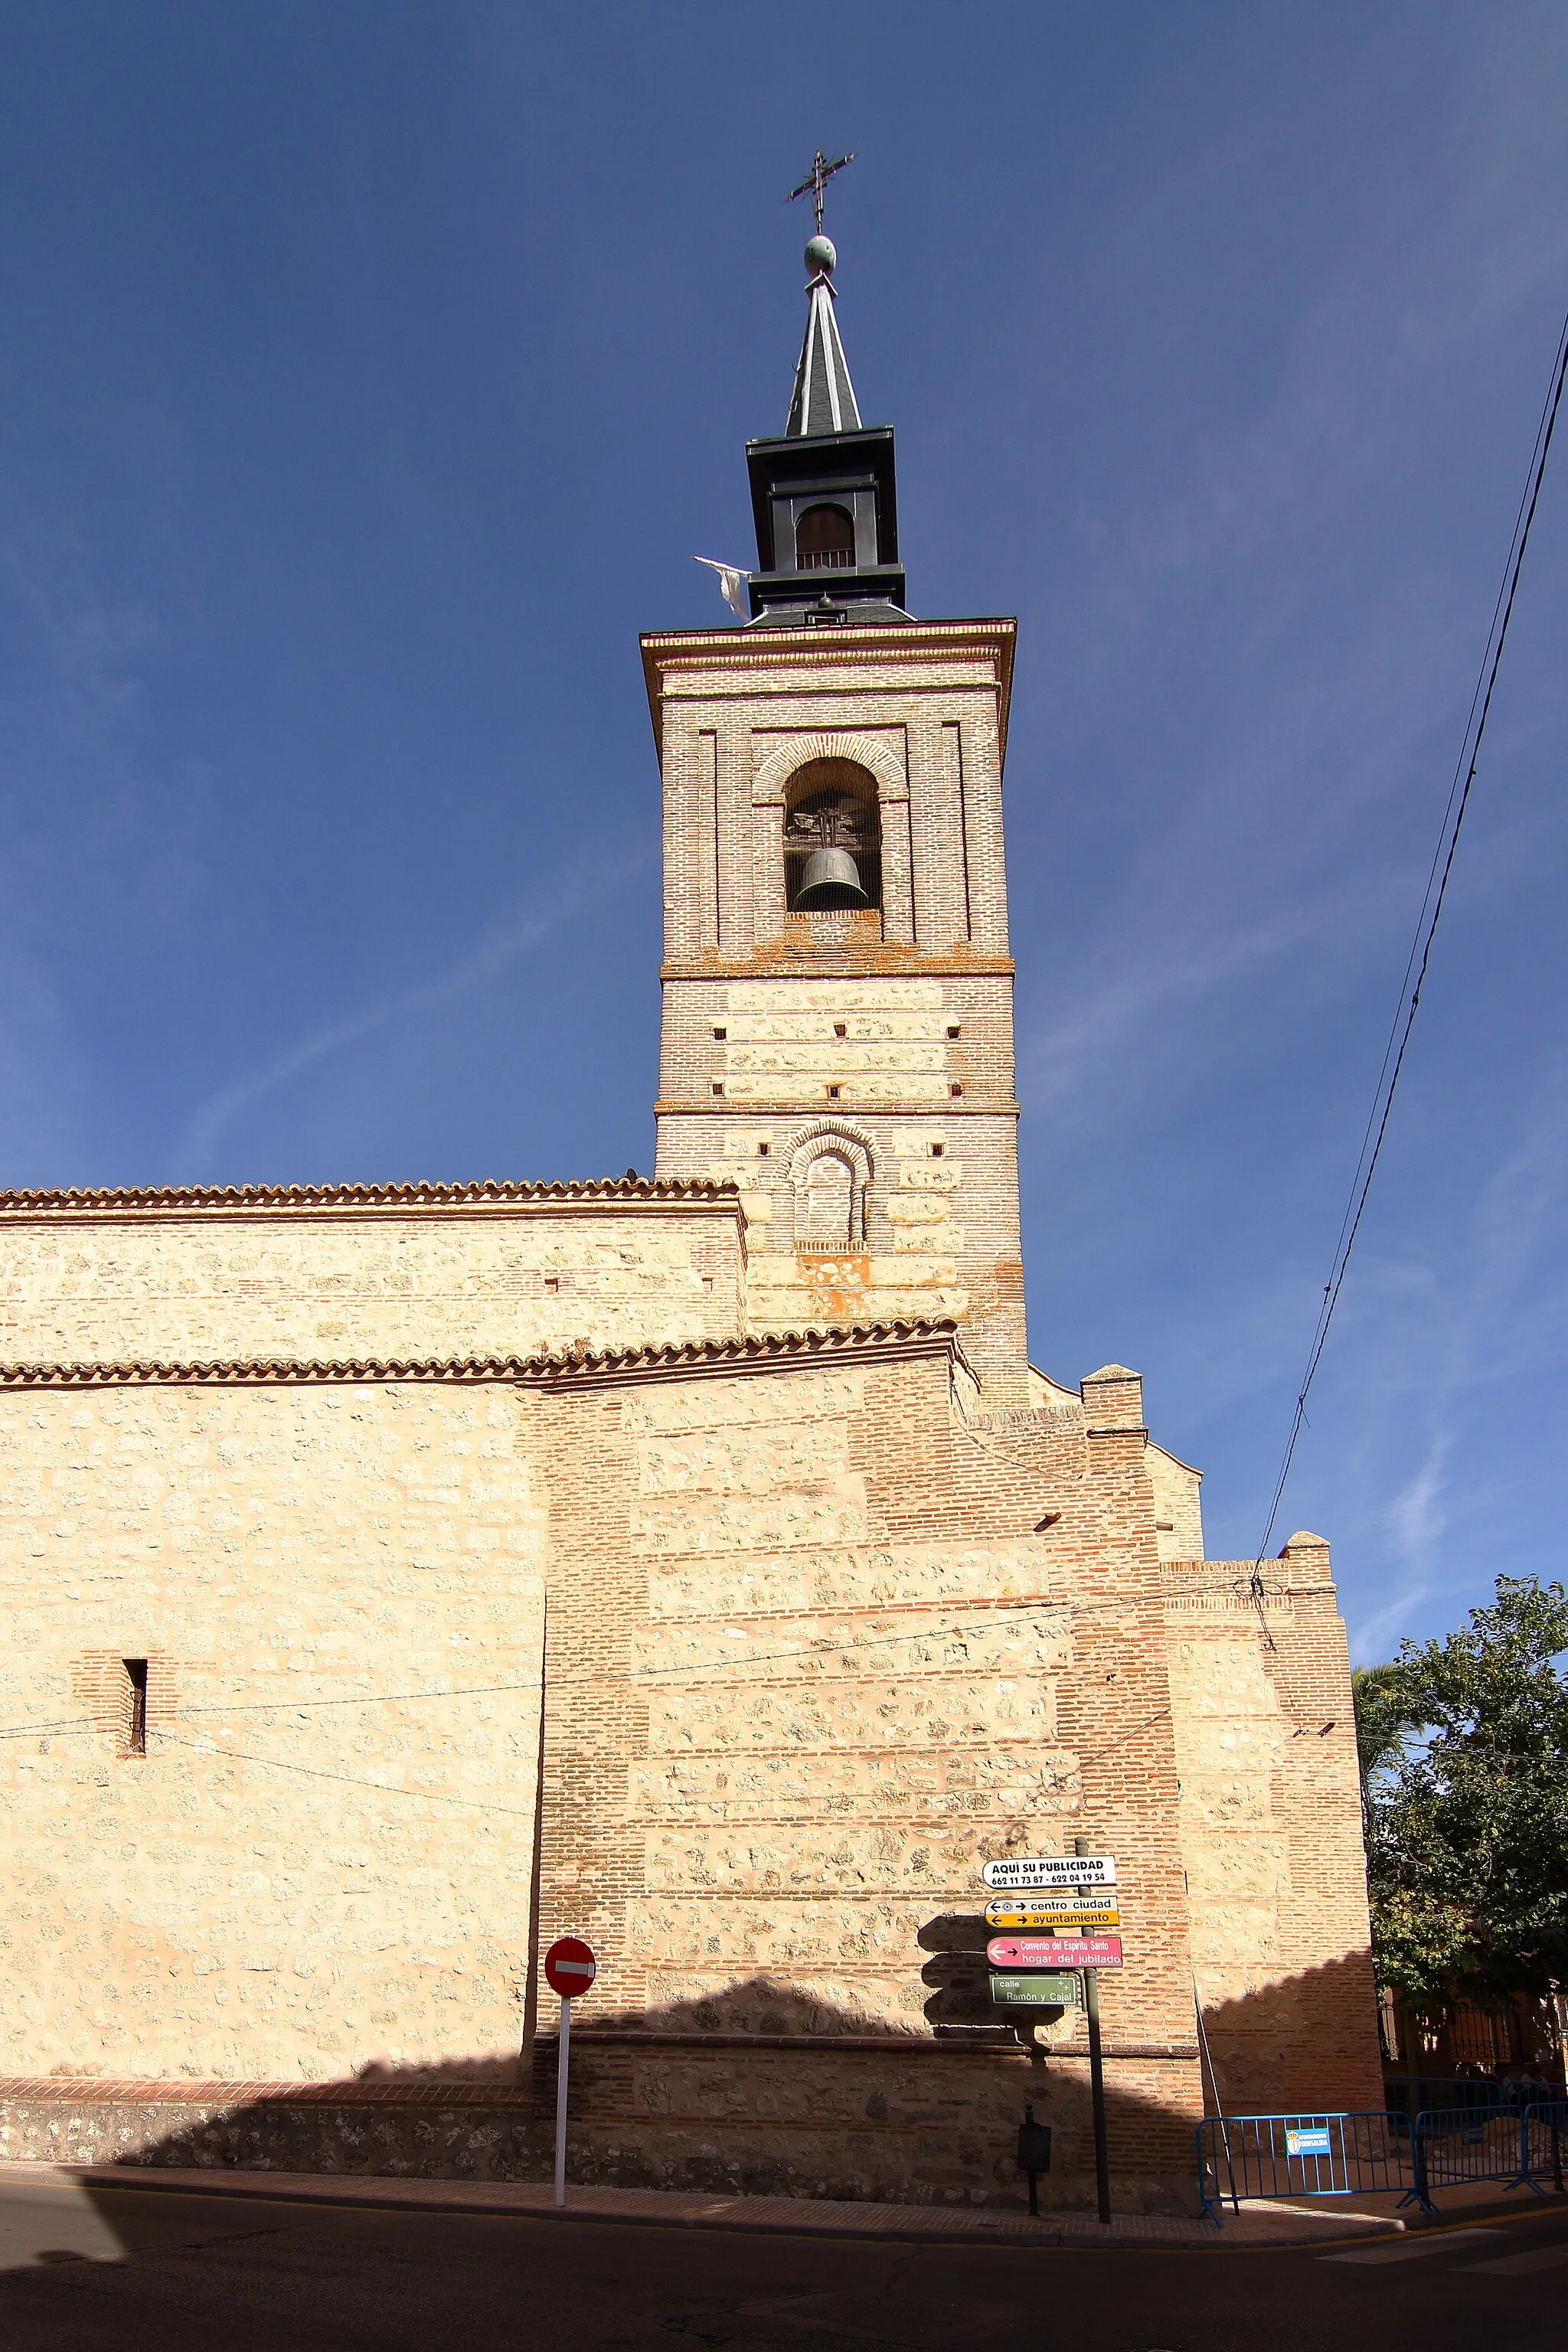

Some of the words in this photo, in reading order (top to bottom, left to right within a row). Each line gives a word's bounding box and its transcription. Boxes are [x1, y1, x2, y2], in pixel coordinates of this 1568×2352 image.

[992, 1862, 1020, 1874] AQUÍ
[1023, 1864, 1036, 1873] SU
[1040, 1860, 1104, 1872] PUBLICIDAD
[1095, 1873, 1105, 1881] 54
[1031, 1902, 1067, 1910] centro
[1073, 1900, 1111, 1909] ciudad
[1033, 1913, 1109, 1925] ayuntamiento
[1021, 1940, 1050, 1951] Convento
[1052, 1940, 1062, 1951] del
[1090, 1940, 1109, 1951] Santo
[1022, 1954, 1053, 1965] hogar
[1057, 1954, 1074, 1963] del
[1078, 1954, 1121, 1965] jubilado
[1040, 1994, 1046, 2002] y
[1050, 1992, 1072, 2002] Cajal
